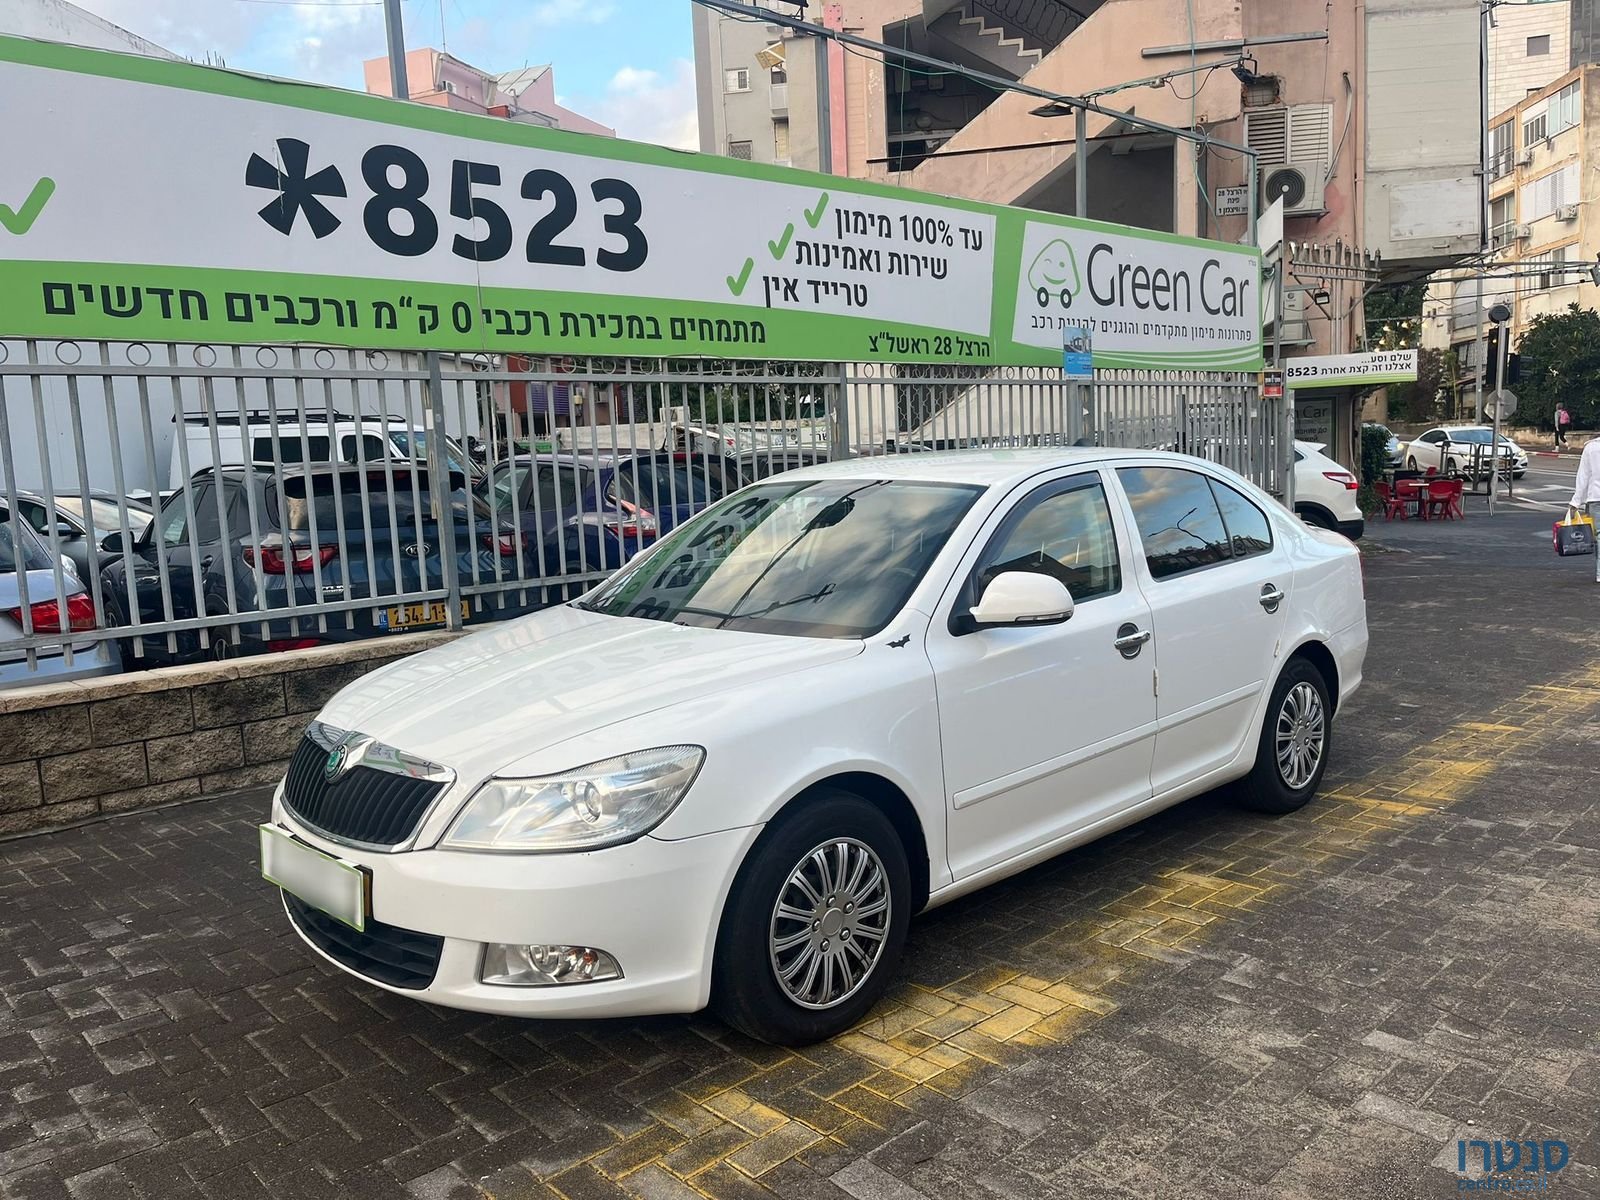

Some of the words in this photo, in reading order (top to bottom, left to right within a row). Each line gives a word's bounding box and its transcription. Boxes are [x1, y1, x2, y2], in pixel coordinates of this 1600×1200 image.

[836, 208, 892, 239] מימון
[900, 215, 954, 247] 100%
[959, 227, 983, 251] עד
[795, 241, 881, 275] ואמינות
[887, 252, 948, 280] שירות
[1086, 243, 1191, 313] Green
[1200, 259, 1250, 318] Car
[42, 282, 209, 321] חדשים
[763, 276, 800, 309] אין
[806, 280, 868, 308] טרייד
[225, 292, 359, 330] ורכבים
[451, 301, 472, 334] 0
[481, 308, 551, 337] רכבי
[1031, 314, 1053, 330] רכב
[560, 312, 663, 340] במכירת
[670, 317, 766, 344] מתמחים
[1101, 320, 1140, 336] והוגנים
[1143, 323, 1189, 341] מתקדמים
[1191, 325, 1216, 341] מימון
[1218, 328, 1252, 342] פתרונות
[934, 335, 953, 355] 28
[956, 335, 990, 358] הרצל
[1371, 363, 1382, 372] זה
[1385, 361, 1412, 371] אצלנו
[1389, 352, 1412, 362] שלם
[1287, 366, 1318, 377] 8523
[1320, 366, 1346, 375] אחרת
[1348, 364, 1369, 374] קצת
[1302, 405, 1328, 418] Car
